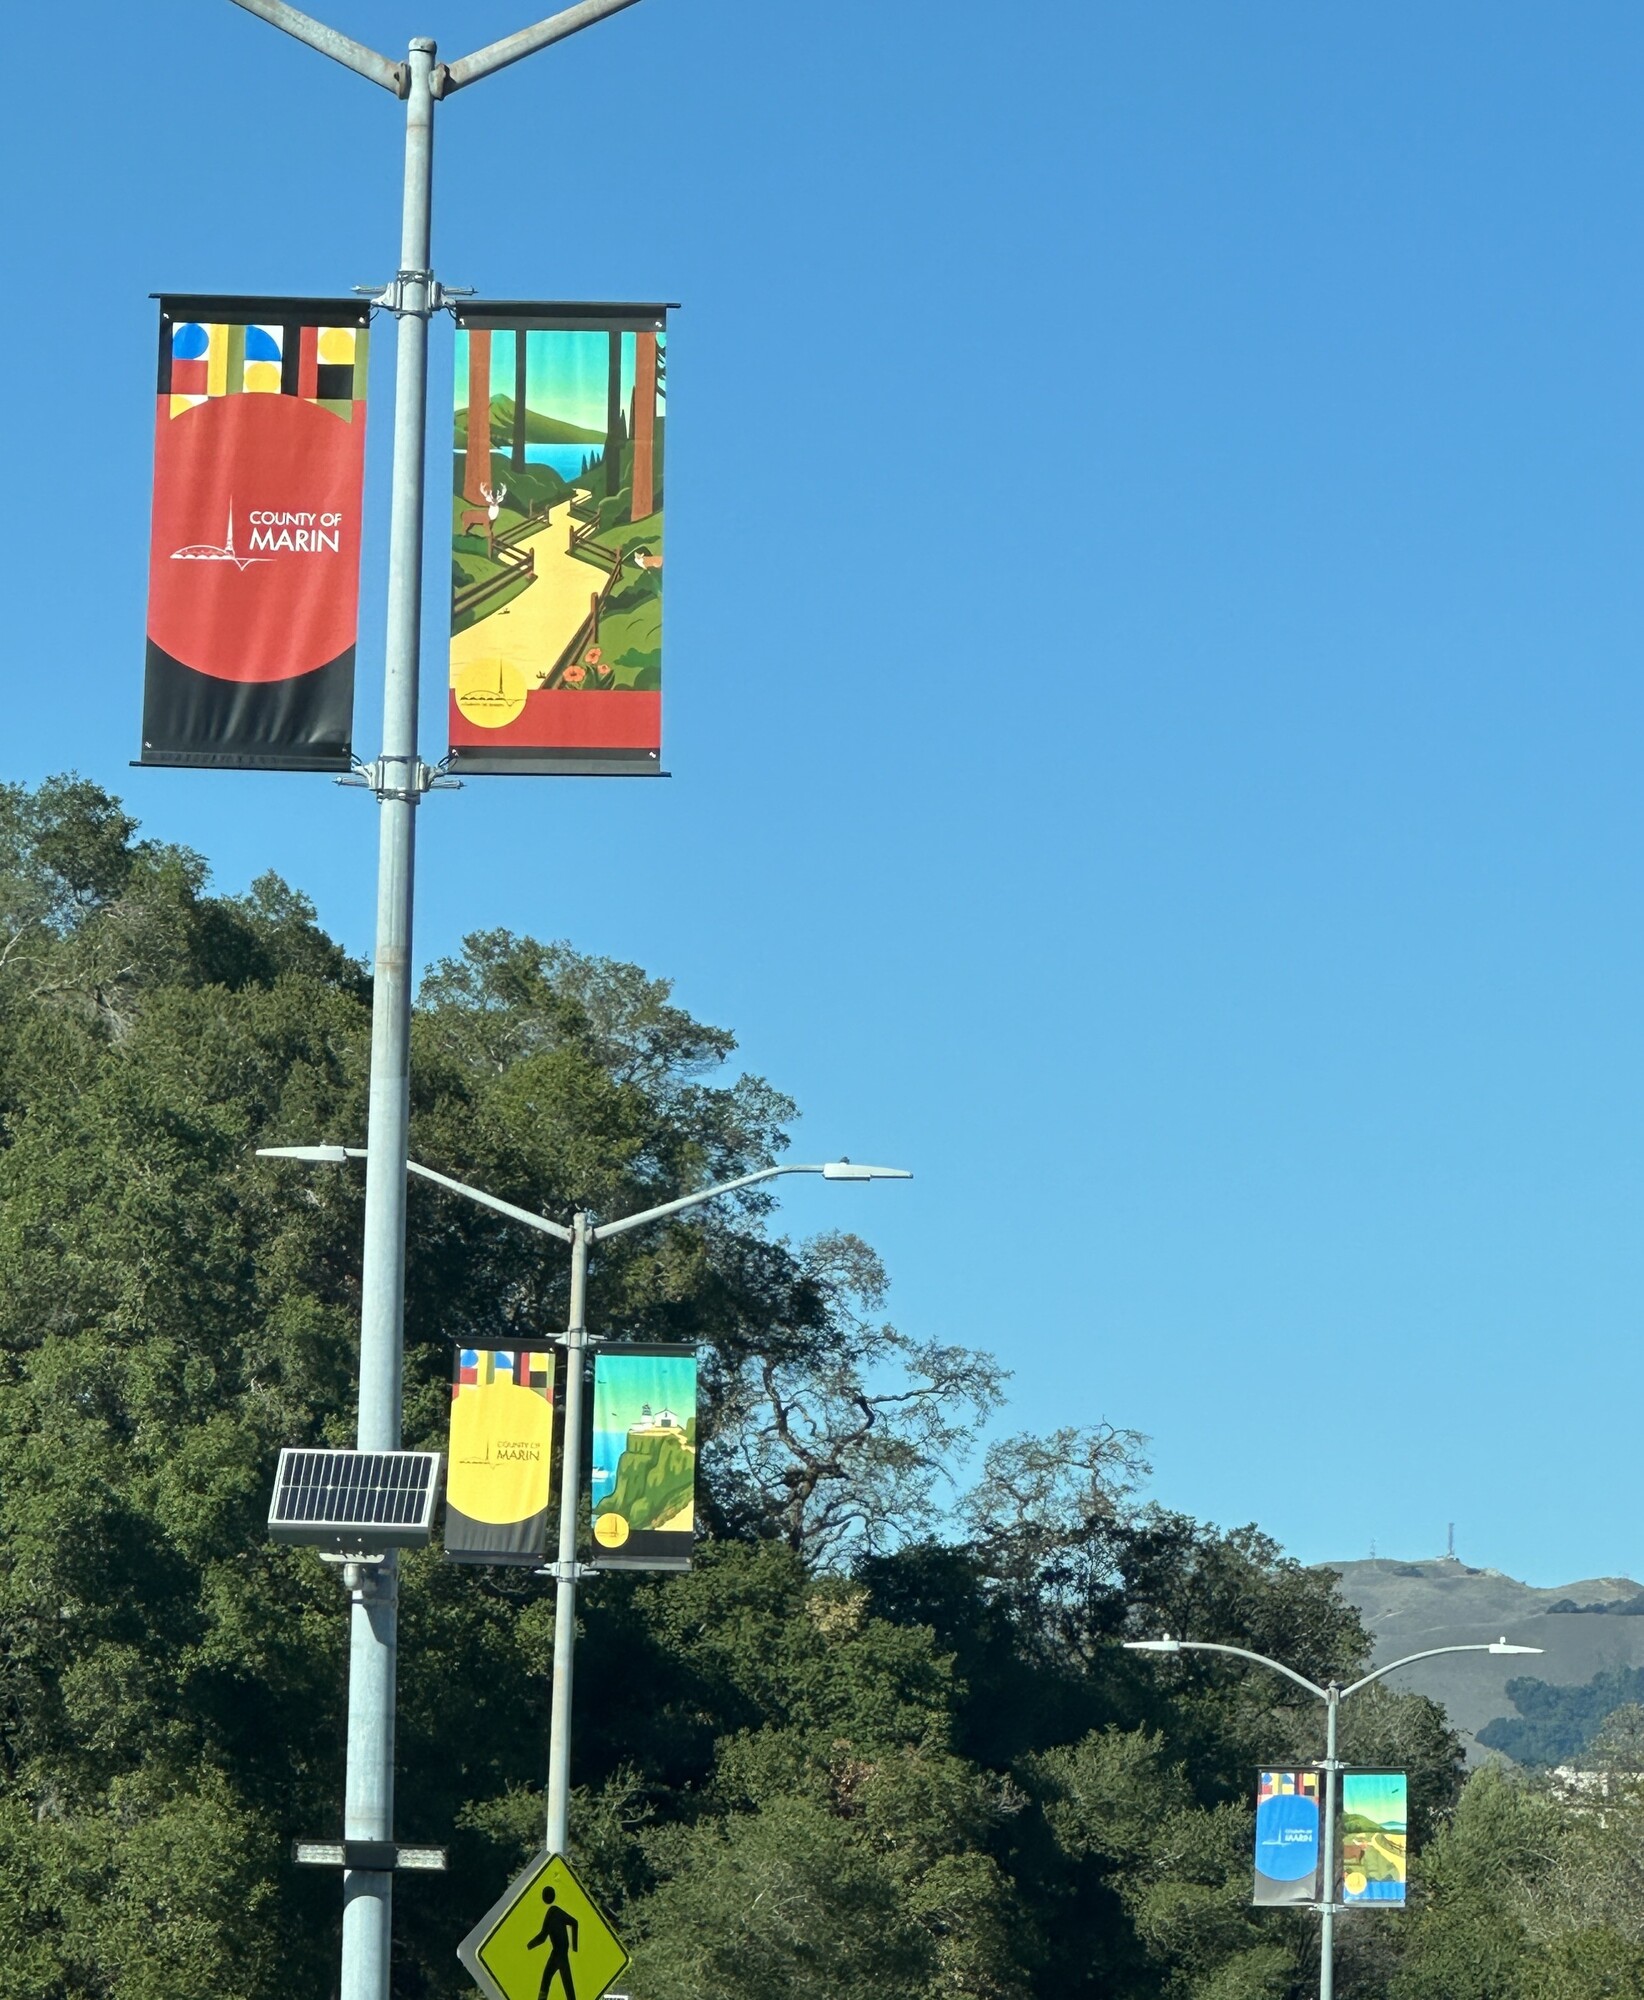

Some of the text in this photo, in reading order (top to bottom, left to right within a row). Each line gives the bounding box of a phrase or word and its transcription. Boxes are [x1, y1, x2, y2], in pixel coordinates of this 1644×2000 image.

[249, 511, 342, 527] COUNTY OF
[249, 527, 340, 552] MARIN
[497, 1449, 540, 1461] MARIN
